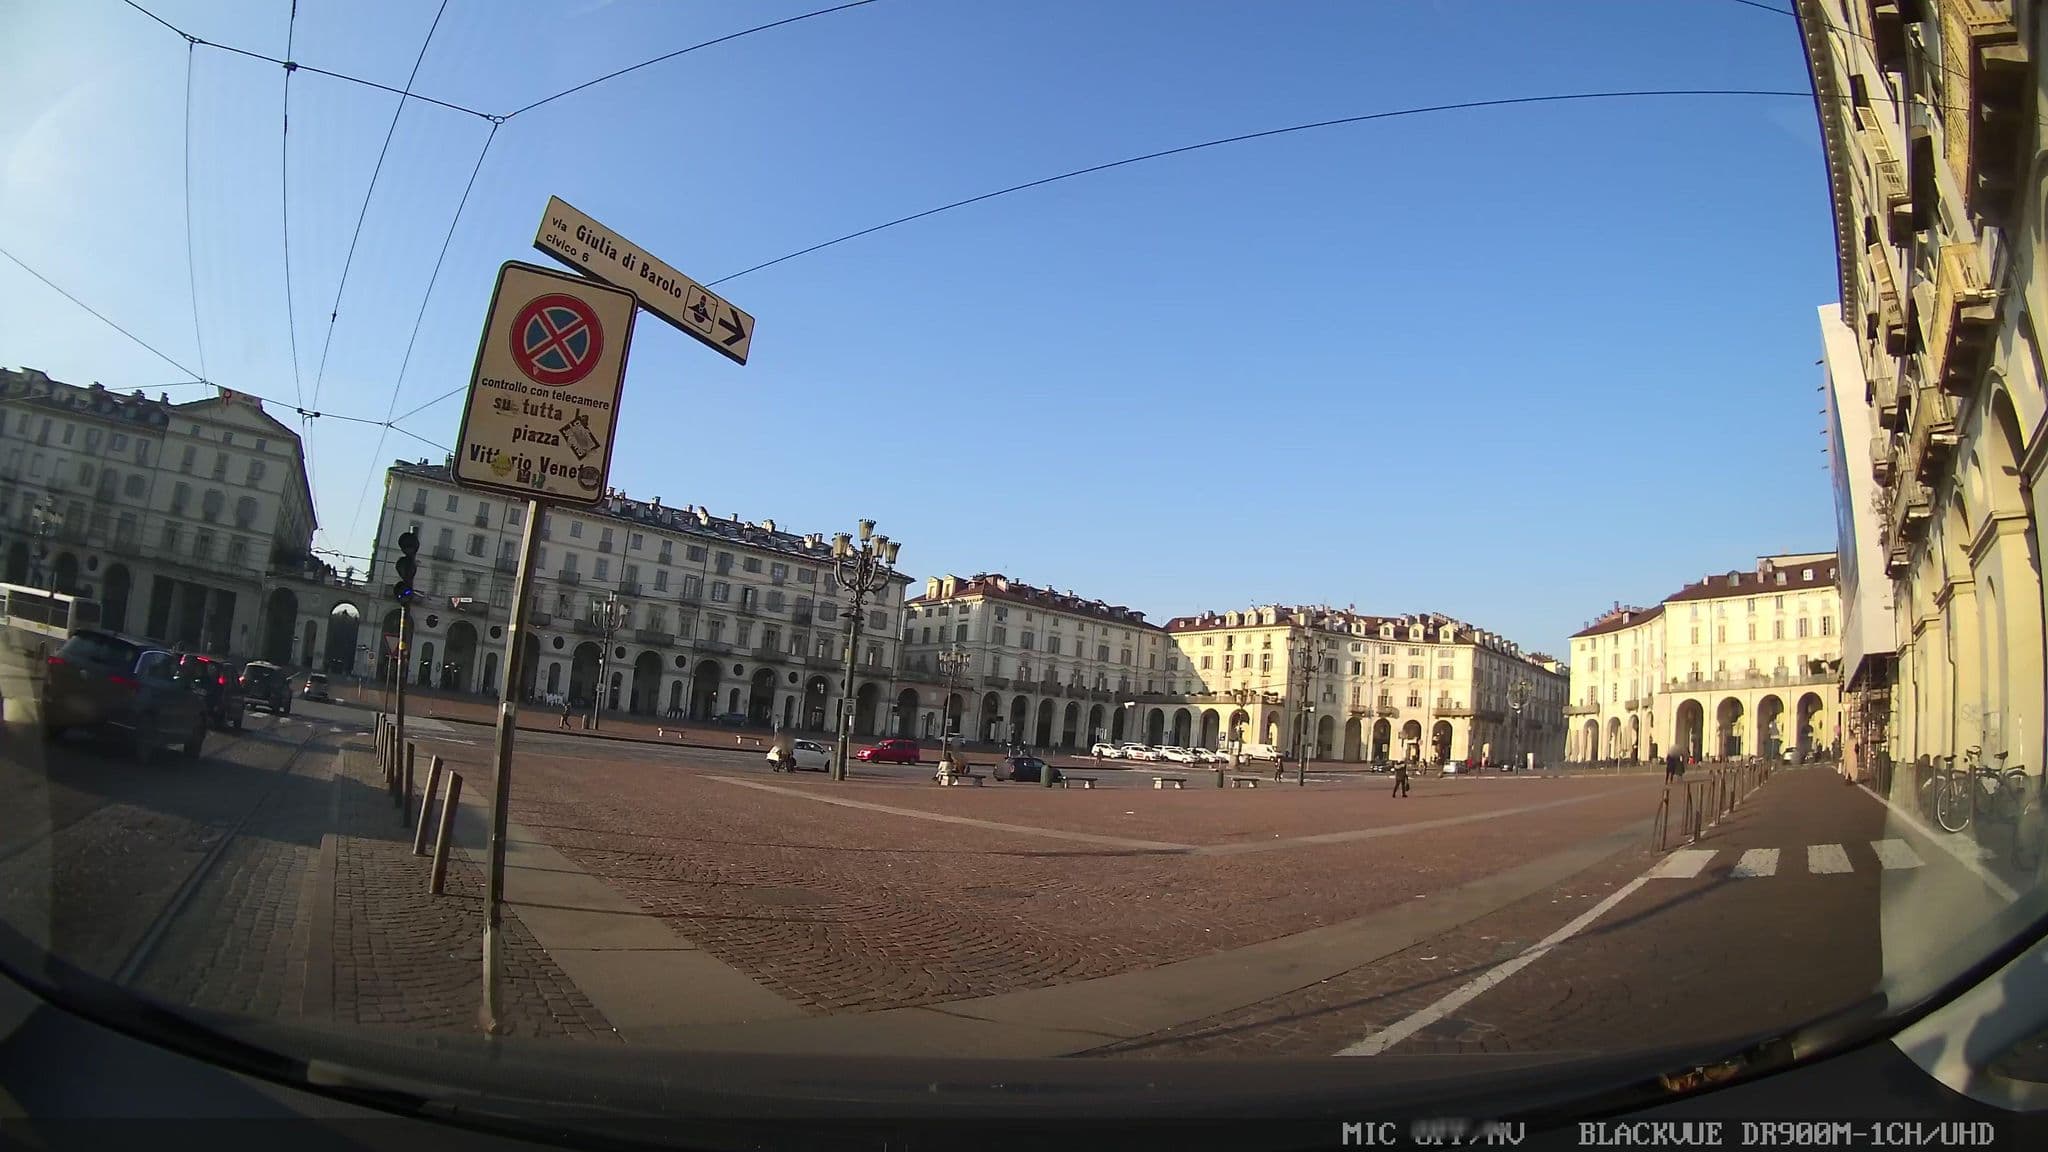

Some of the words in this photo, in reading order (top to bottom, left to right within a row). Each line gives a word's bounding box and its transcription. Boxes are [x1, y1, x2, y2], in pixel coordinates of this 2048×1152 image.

[545, 234, 577, 256] civico
[582, 252, 589, 263] 6
[552, 216, 567, 232] via
[576, 225, 618, 261] Giulia
[622, 252, 637, 271] di
[639, 262, 682, 299] Barolo
[481, 377, 528, 394] controllo
[530, 387, 549, 398] con
[552, 390, 610, 410] telecamere
[493, 397, 512, 411] su
[522, 399, 563, 421] tutta
[512, 424, 560, 447] piazza
[470, 443, 532, 471] Vitrio
[540, 456, 585, 479] Vene
